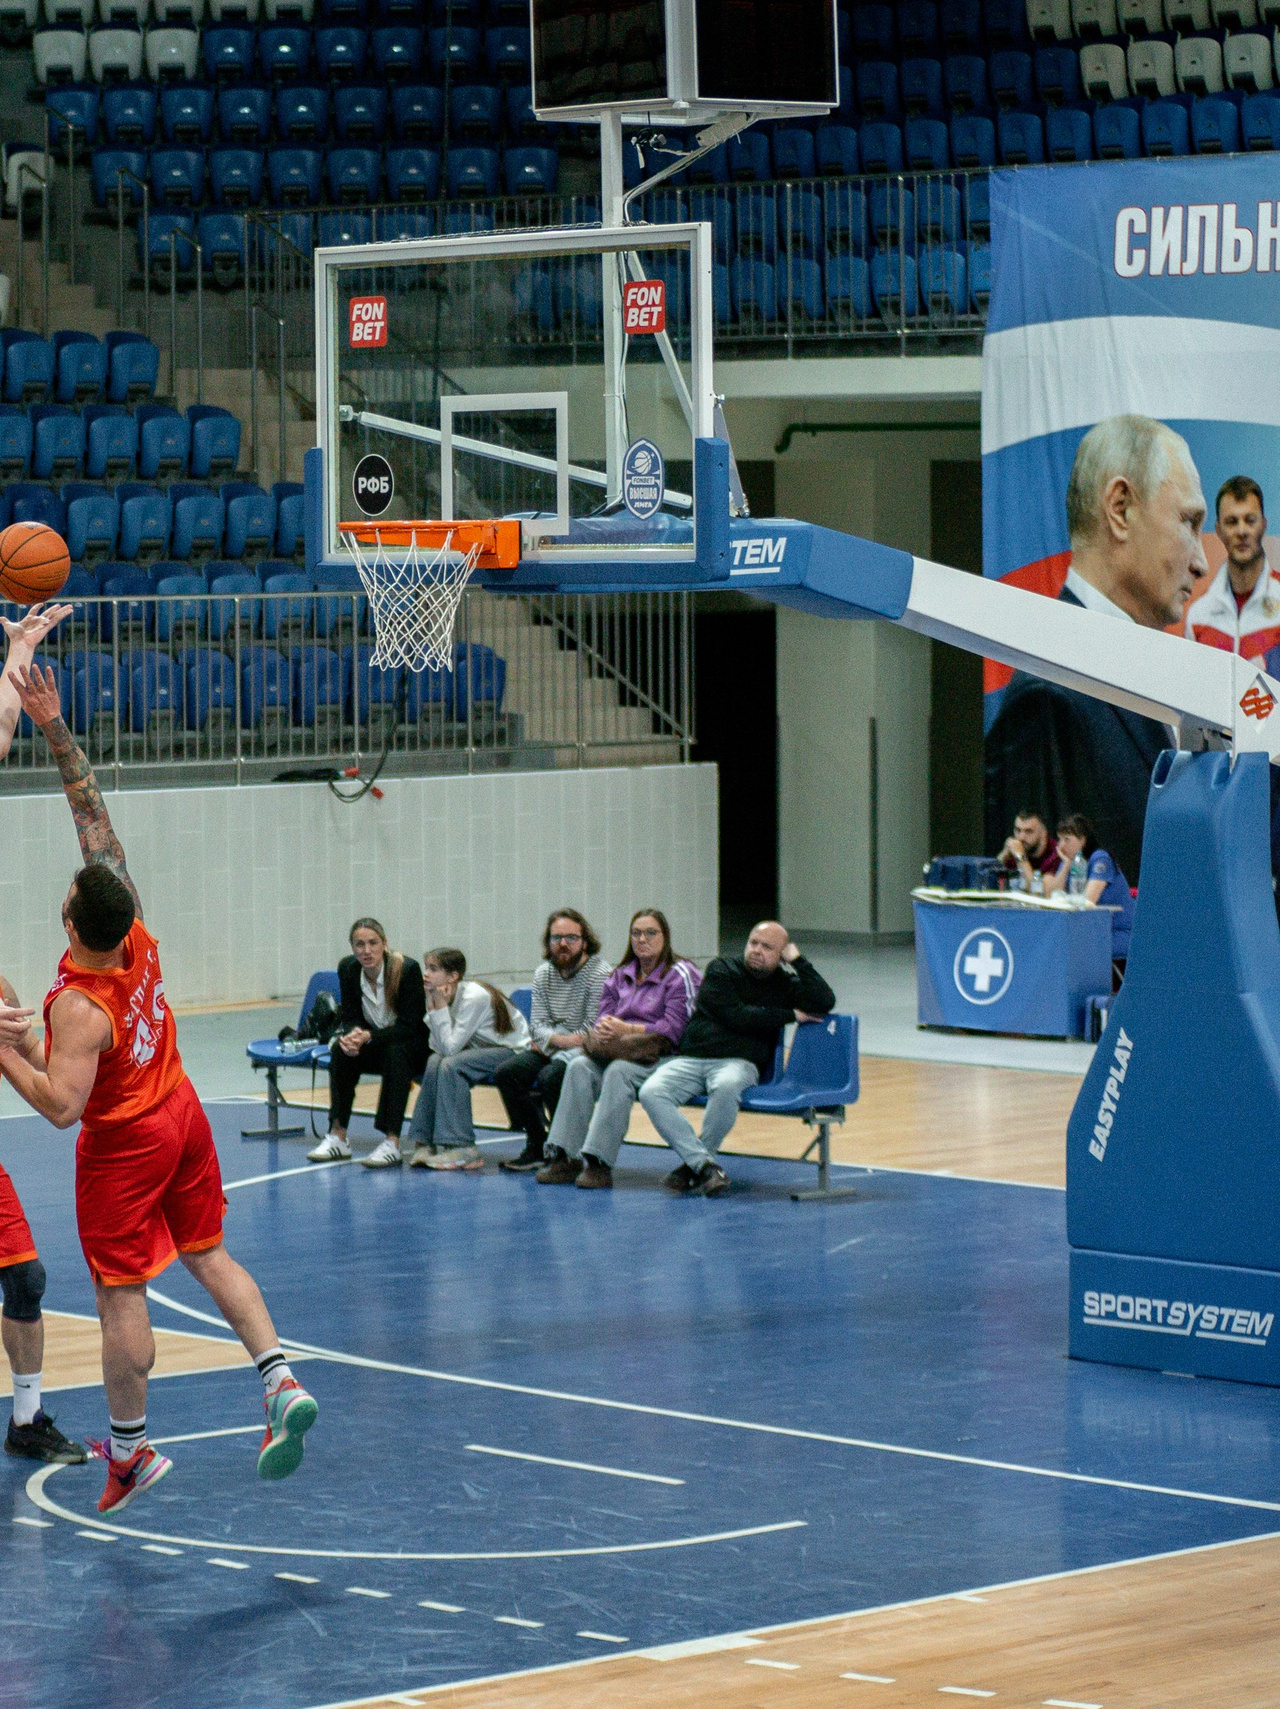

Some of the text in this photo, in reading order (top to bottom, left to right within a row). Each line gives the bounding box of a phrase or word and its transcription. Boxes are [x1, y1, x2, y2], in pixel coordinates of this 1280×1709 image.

[1114, 200, 1280, 278] СИЛЬН
[626, 286, 662, 306] FON
[352, 302, 384, 321] FON
[626, 306, 662, 328] BET
[352, 321, 384, 341] BET
[358, 476, 389, 494] РФБ
[629, 487, 658, 500] ВЫСШАЯ
[729, 536, 788, 566] TEM
[1088, 1027, 1133, 1163] EASYPLAY
[1083, 1290, 1275, 1338] SPORTSYSTEM
